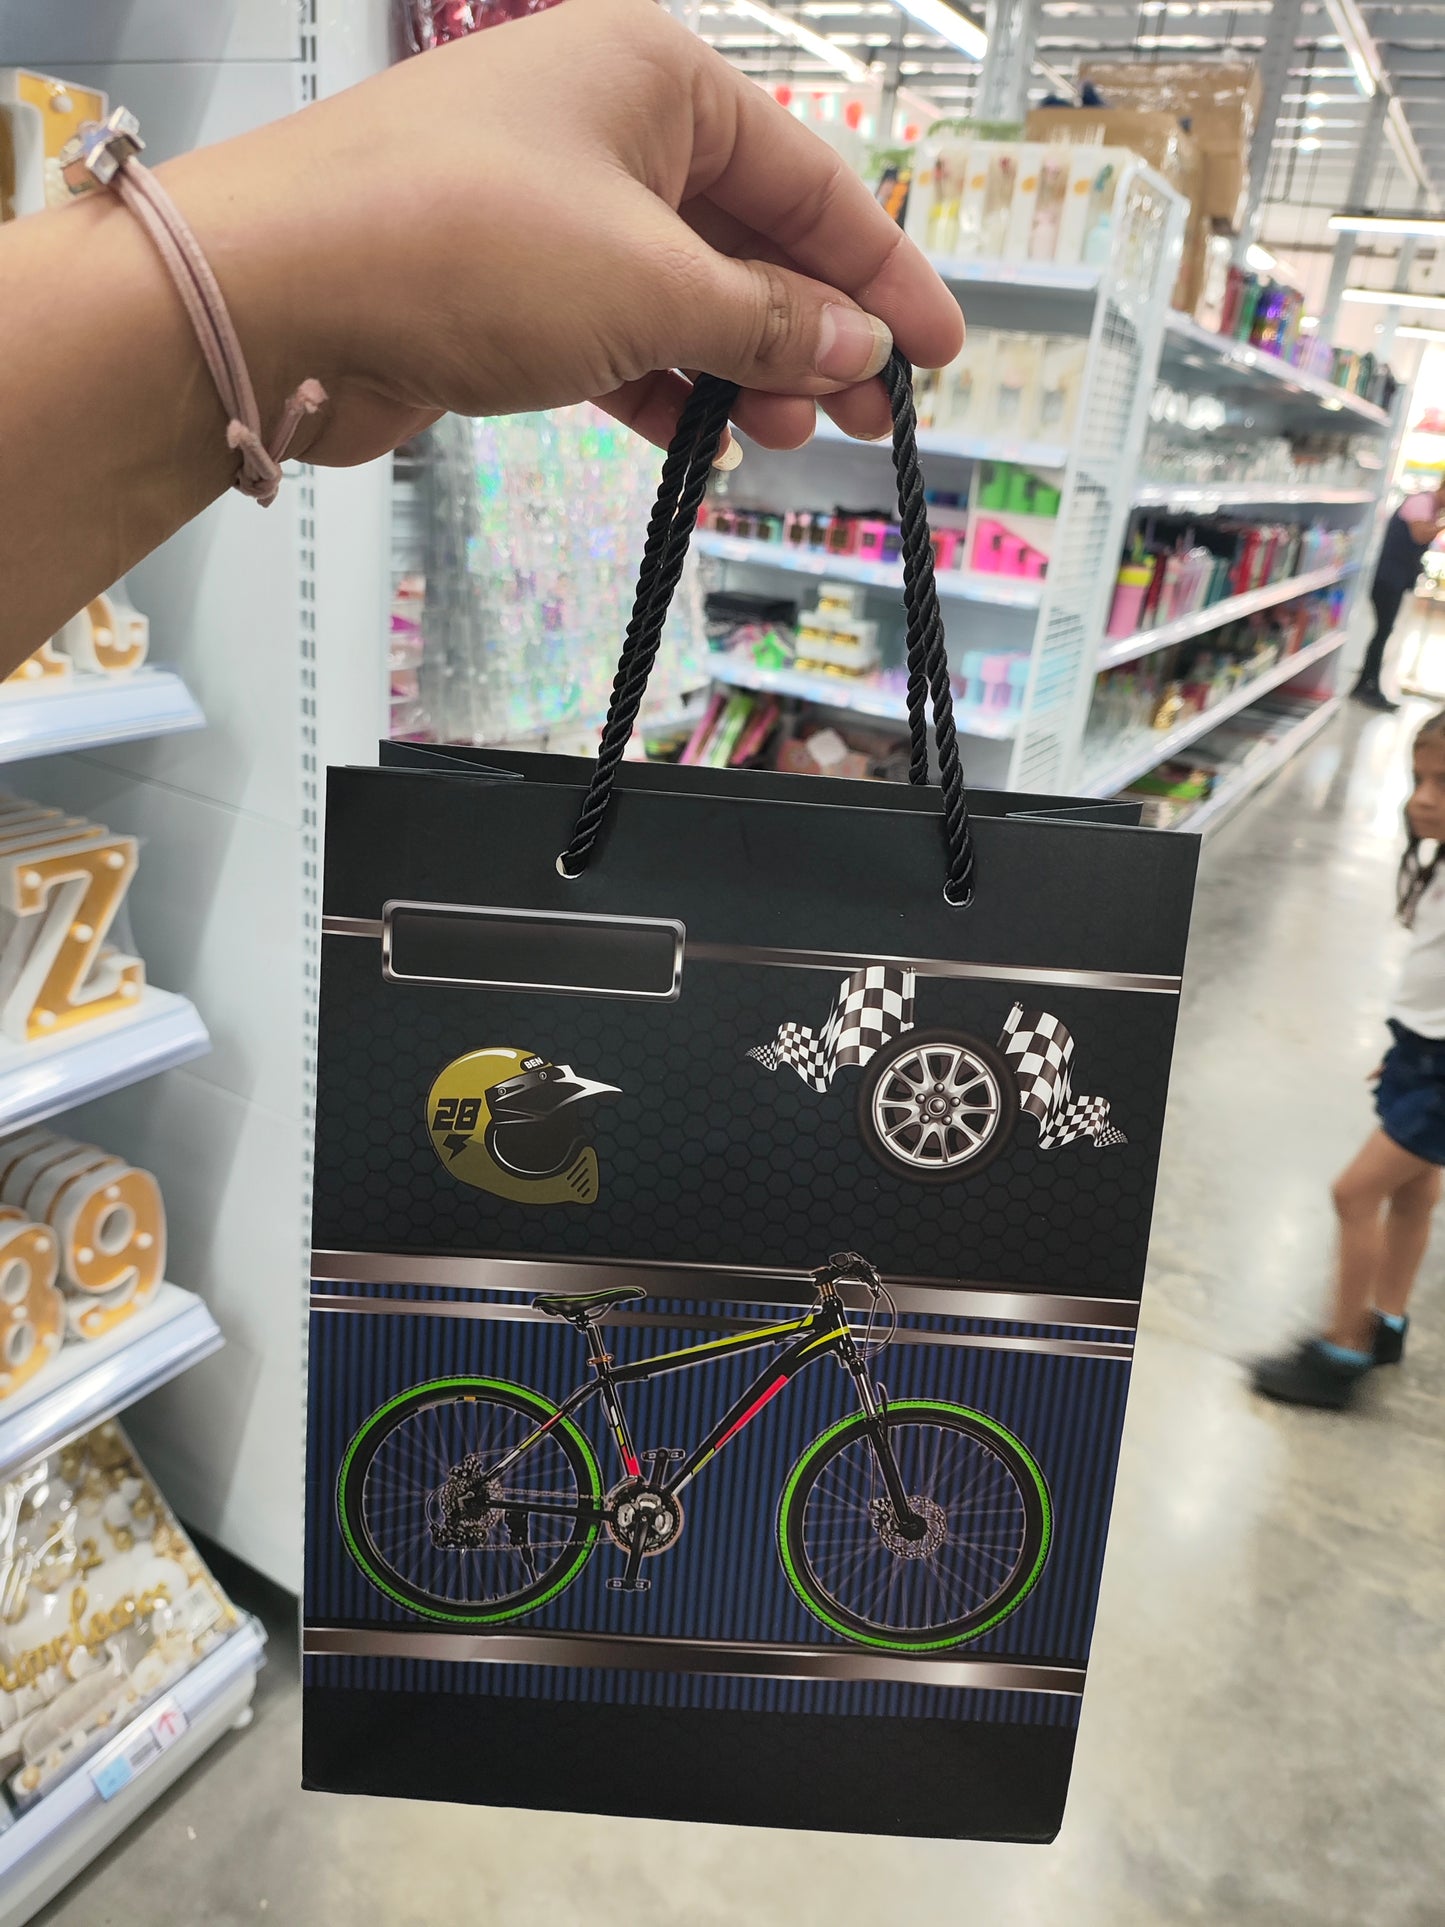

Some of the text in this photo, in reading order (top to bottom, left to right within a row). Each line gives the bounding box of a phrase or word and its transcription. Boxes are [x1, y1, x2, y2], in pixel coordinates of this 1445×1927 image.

[13, 834, 146, 1042] Z
[431, 1098, 482, 1131] 28
[523, 1056, 544, 1069] BEN
[65, 1167, 167, 1342] 9
